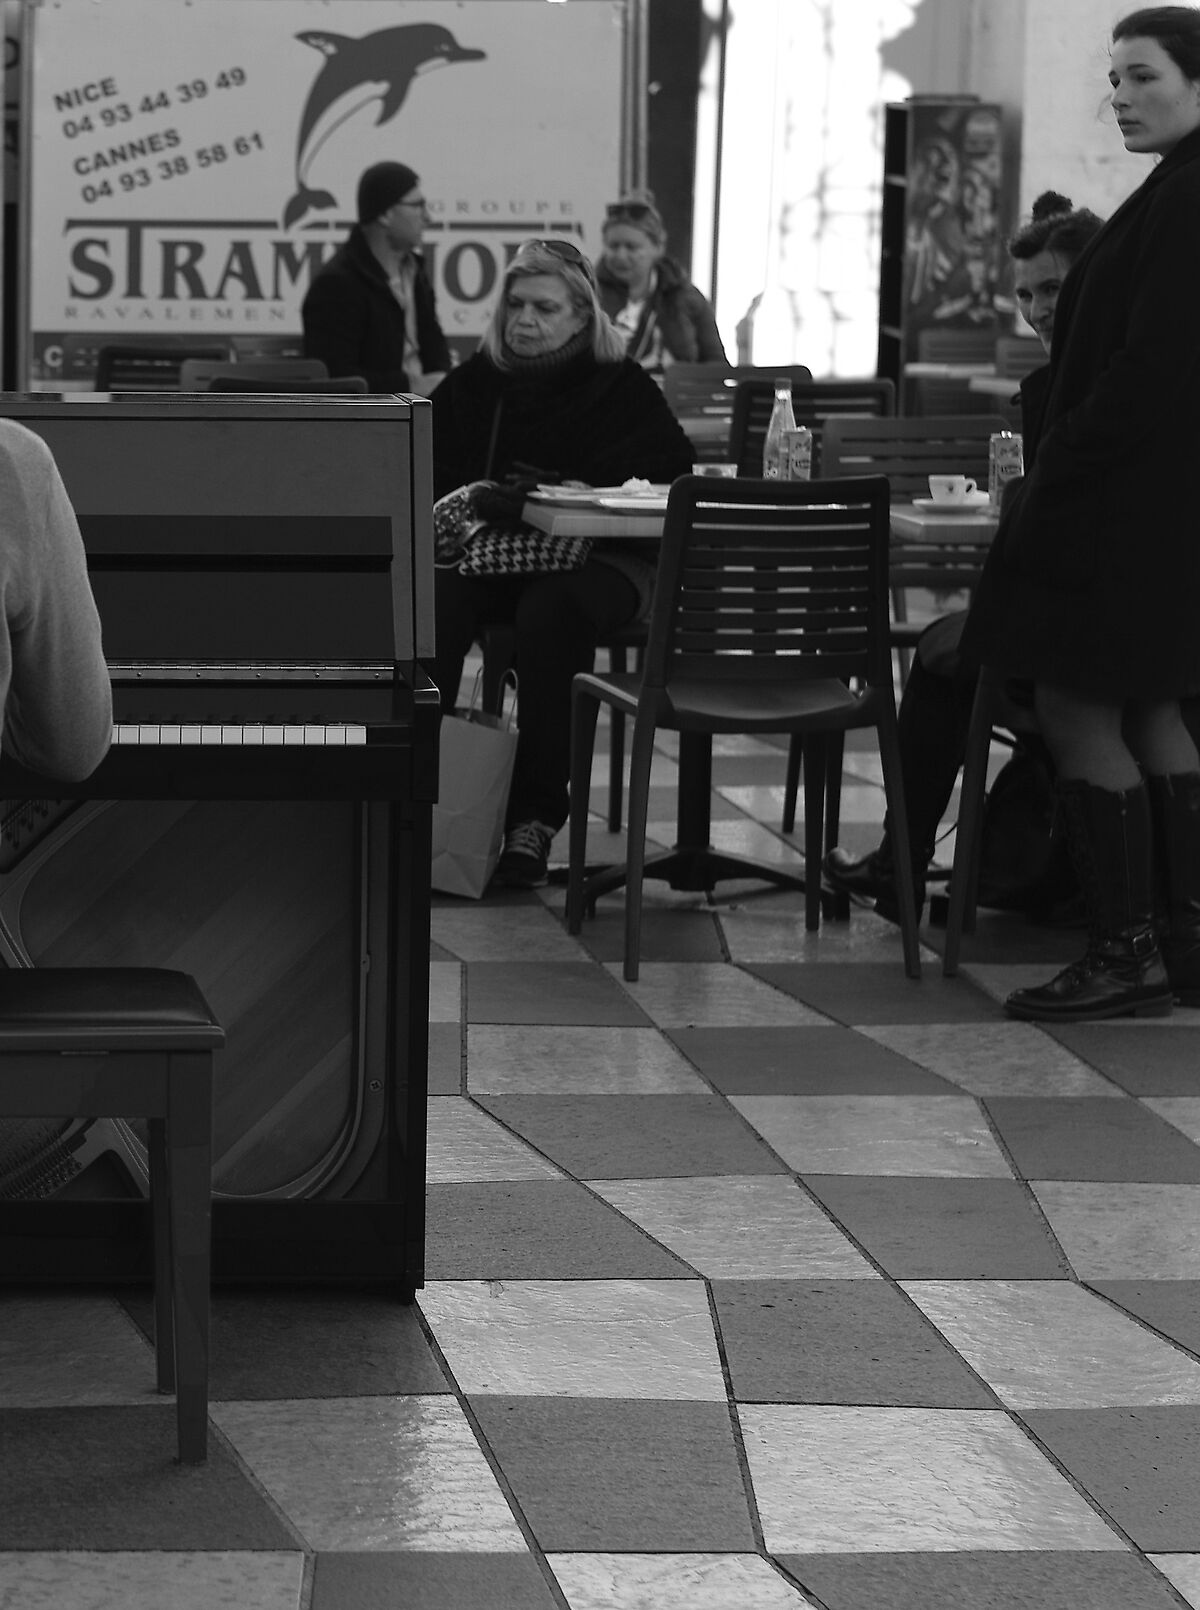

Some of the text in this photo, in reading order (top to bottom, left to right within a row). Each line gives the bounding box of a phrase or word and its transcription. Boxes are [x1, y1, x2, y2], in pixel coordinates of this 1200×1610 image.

[54, 77, 118, 112] NICE
[62, 67, 246, 138] 04 93 44 39 49
[73, 129, 181, 175] CANNES
[81, 131, 263, 204] 04 93 38 58 61
[428, 201, 574, 215] GROUPE
[64, 306, 303, 321] RAVALEMEN
